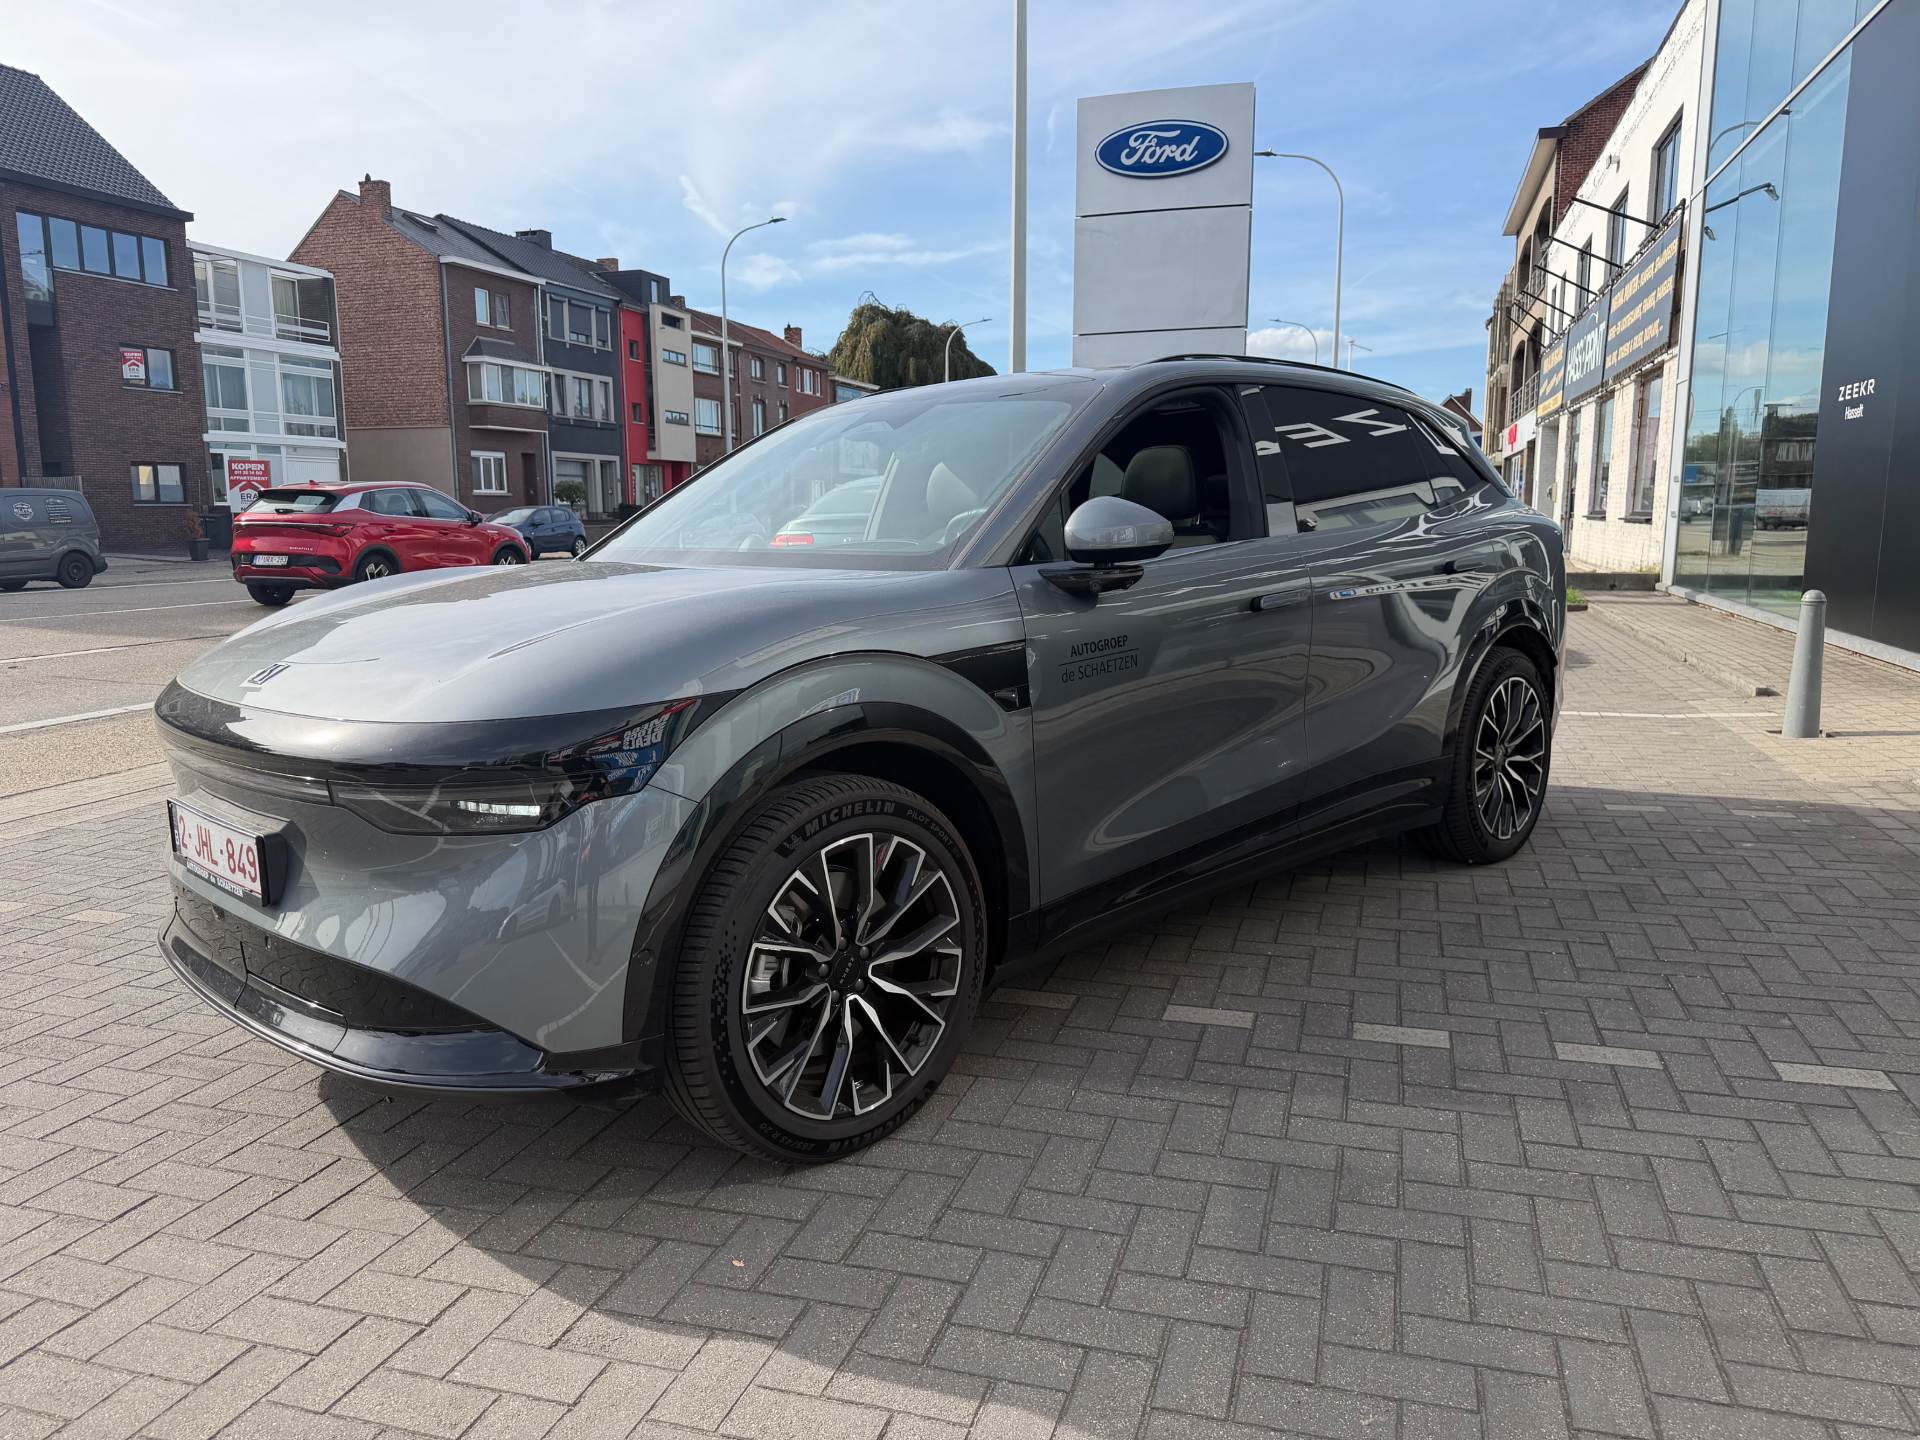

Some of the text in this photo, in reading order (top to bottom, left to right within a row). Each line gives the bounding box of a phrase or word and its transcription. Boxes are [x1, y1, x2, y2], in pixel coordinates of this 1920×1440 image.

[1120, 129, 1201, 166] Ford
[1838, 378, 1875, 402] ZEEKR
[1844, 403, 1864, 420] Hasselt
[231, 462, 265, 471] KOPEN
[1070, 635, 1128, 658] AUTOGROEP
[1061, 654, 1138, 683] de SCHAETZEN
[804, 801, 896, 838] MICHELIN
[906, 809, 940, 826] PILOT
[930, 822, 954, 847] SPORT
[186, 860, 209, 879] AUTOGROEP
[217, 876, 244, 898] SCHAETZEN
[758, 1101, 915, 1153] MICHELIN 265/45 R 20
